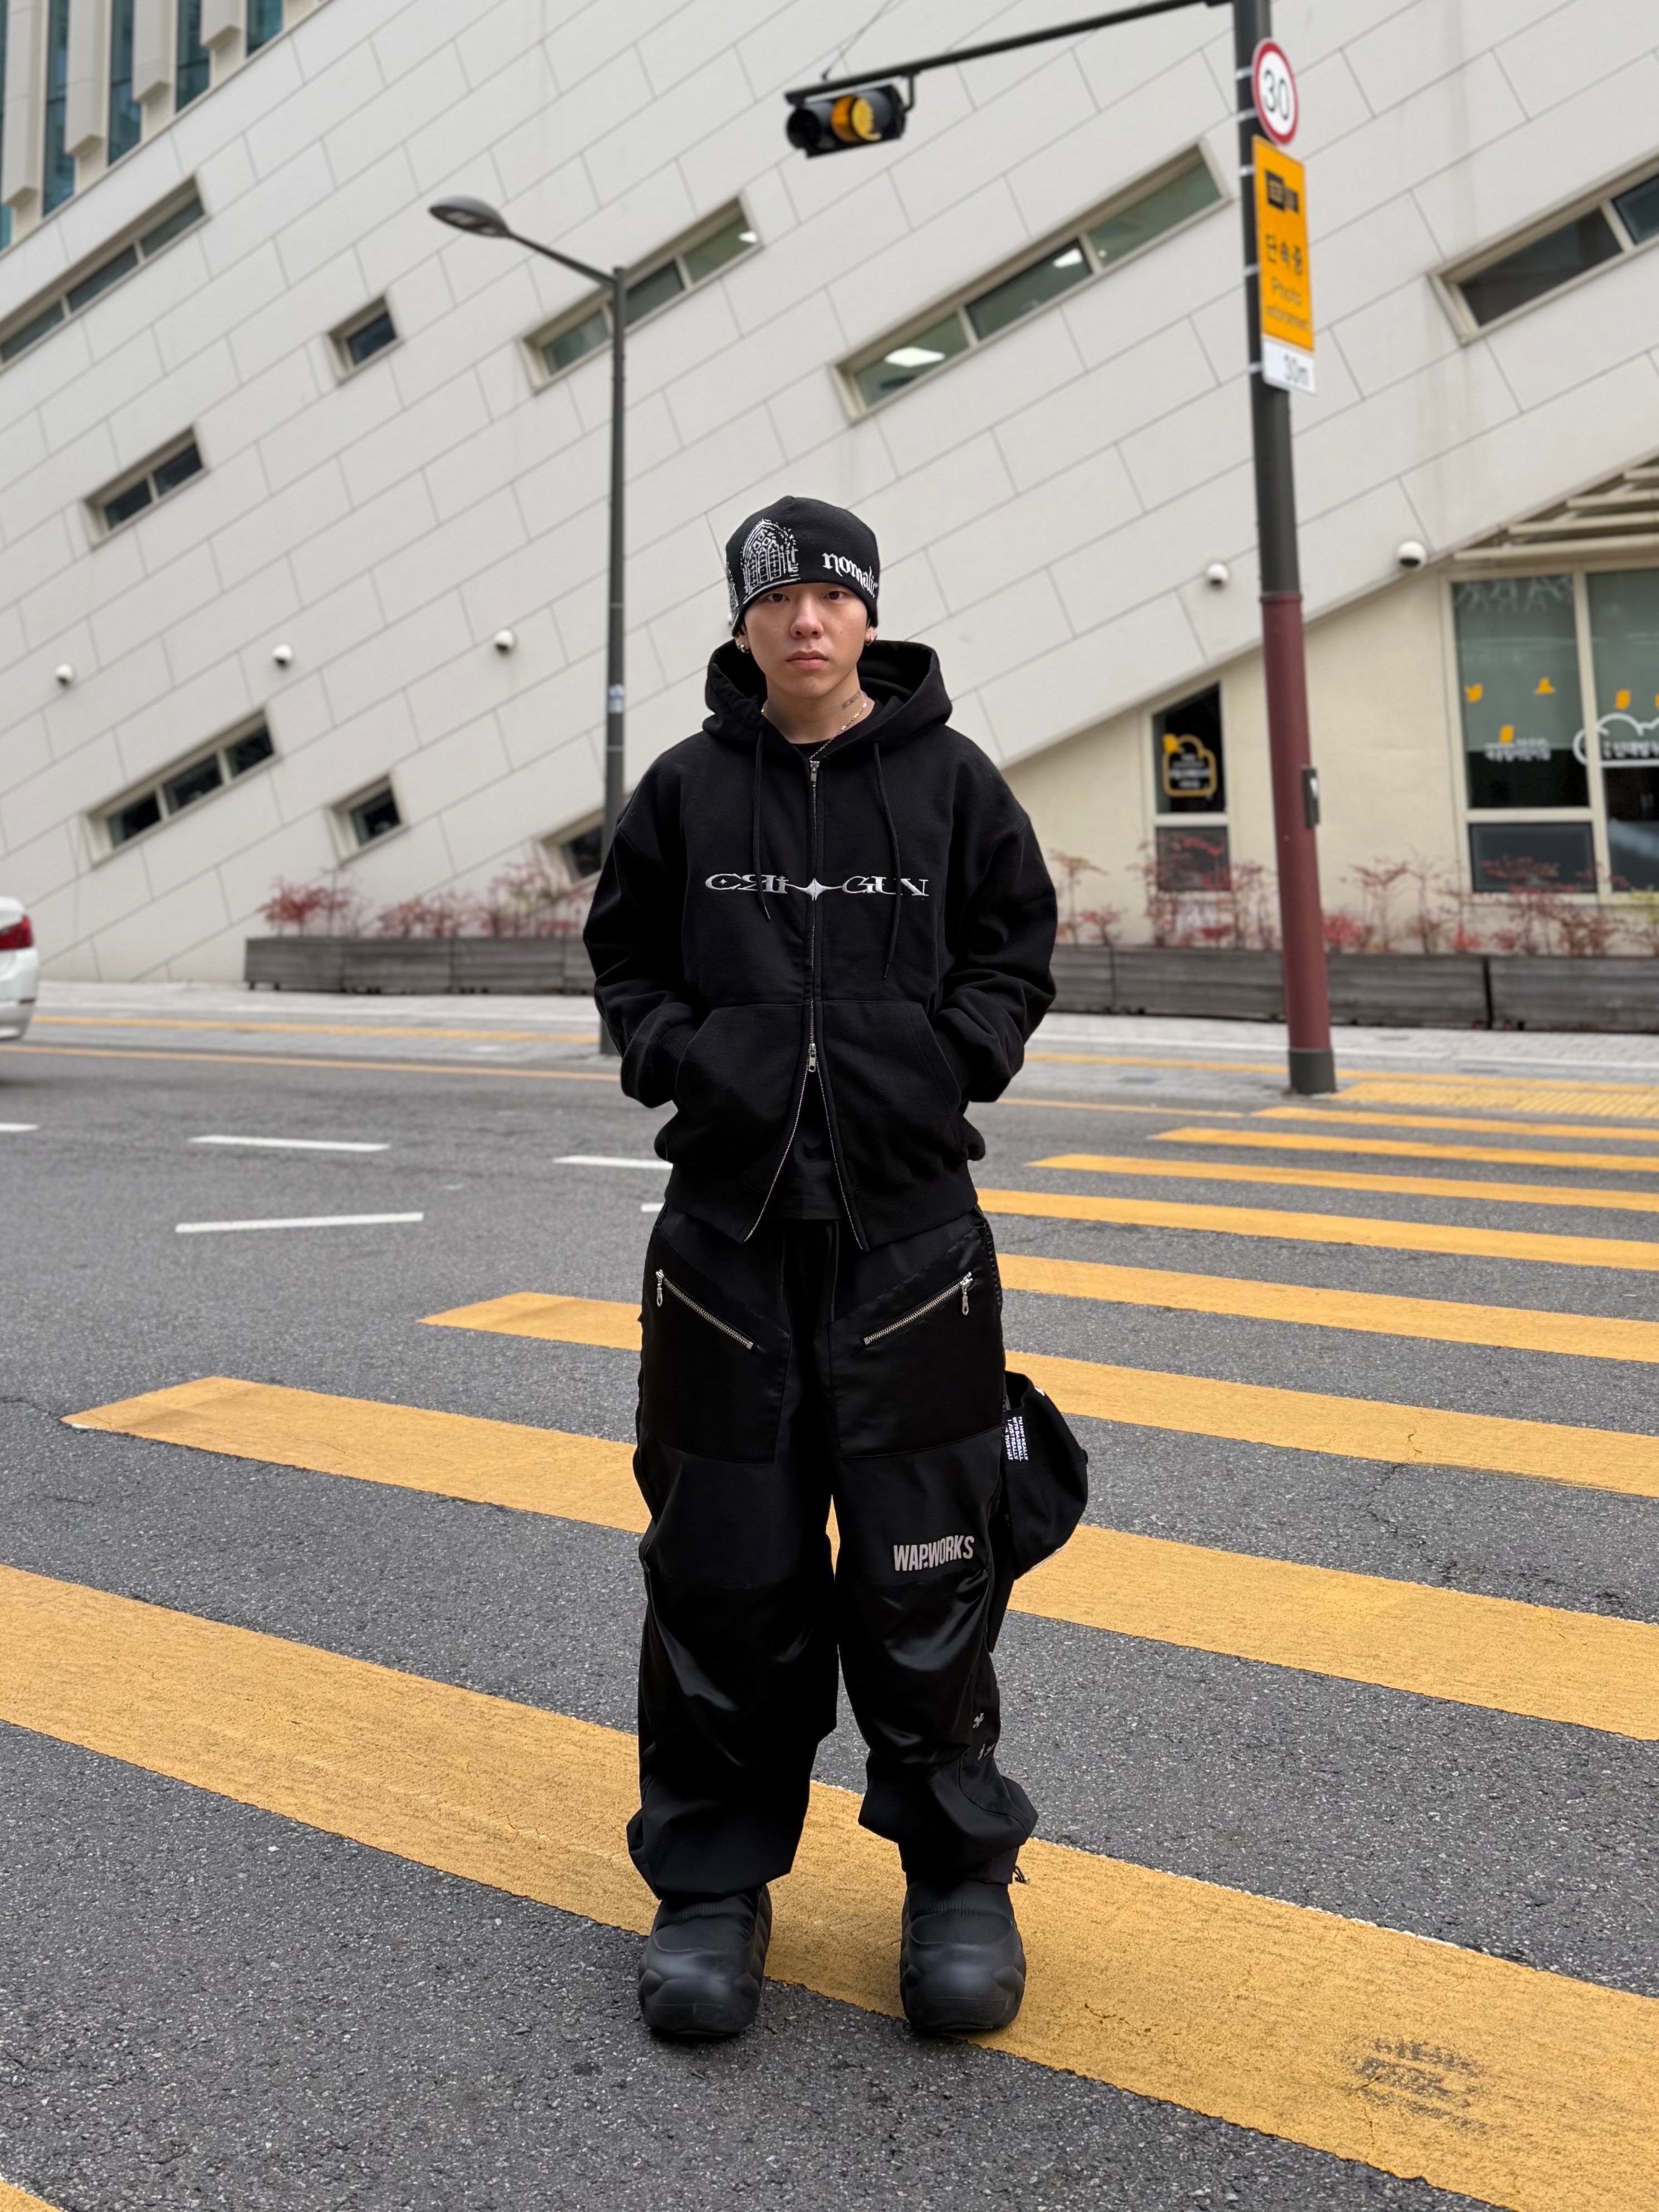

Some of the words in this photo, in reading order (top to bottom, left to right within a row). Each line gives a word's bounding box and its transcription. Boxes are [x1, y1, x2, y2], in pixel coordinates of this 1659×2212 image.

[1264, 69, 1290, 120] 30
[1011, 1437, 1019, 1460] REALLY
[1015, 1430, 1023, 1461] BASEBALL
[893, 1535, 974, 1571] WAPWORKS
